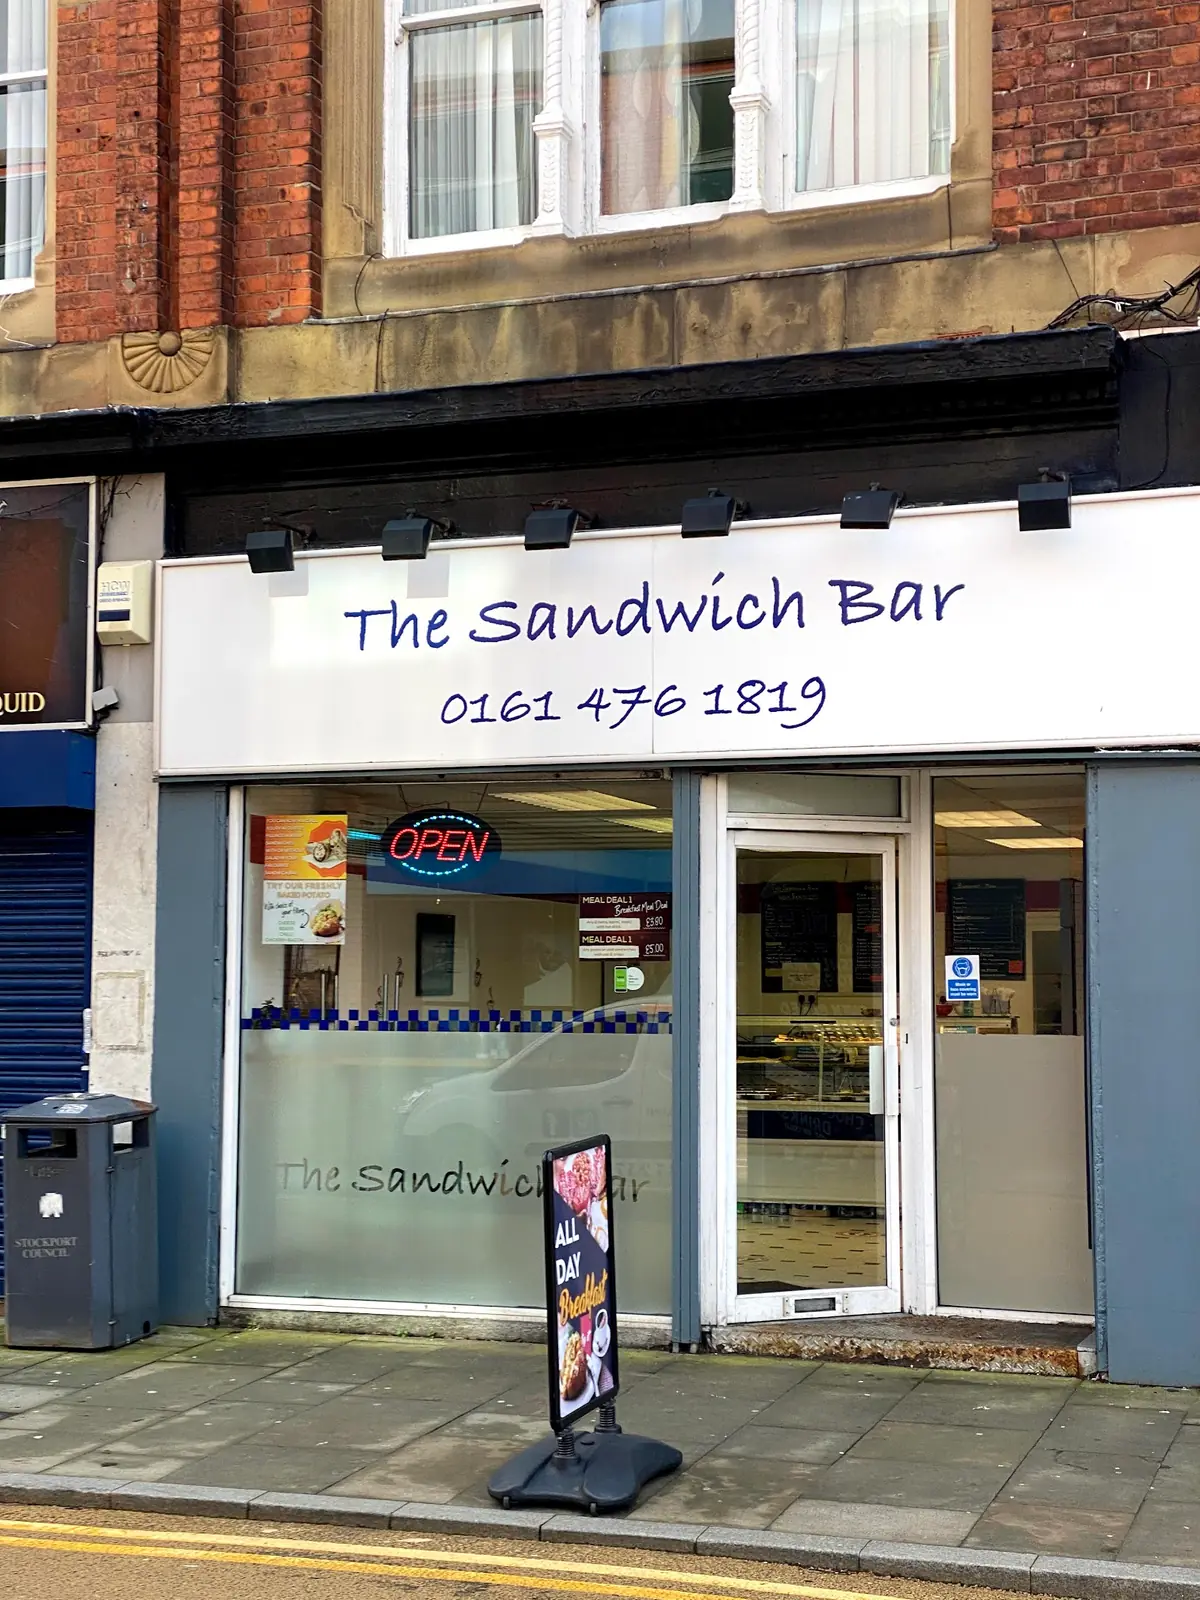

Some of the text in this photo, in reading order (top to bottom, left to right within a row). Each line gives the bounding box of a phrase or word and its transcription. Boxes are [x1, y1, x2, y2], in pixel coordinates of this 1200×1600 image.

[344, 573, 964, 651] The Sandwich Bar
[441, 676, 826, 729] 0161 476 1819
[389, 828, 490, 862] OPEN
[582, 896, 633, 904] MEAL DEAL 1
[614, 904, 641, 917] Breakfast
[276, 1158, 341, 1192] The
[612, 1175, 651, 1202] ar
[14, 1236, 79, 1248] STOCKPORT
[555, 1217, 580, 1249] ALL
[22, 1248, 71, 1259] COUNCIL
[556, 1251, 581, 1285] DAY
[559, 1268, 608, 1326] Breakfast
